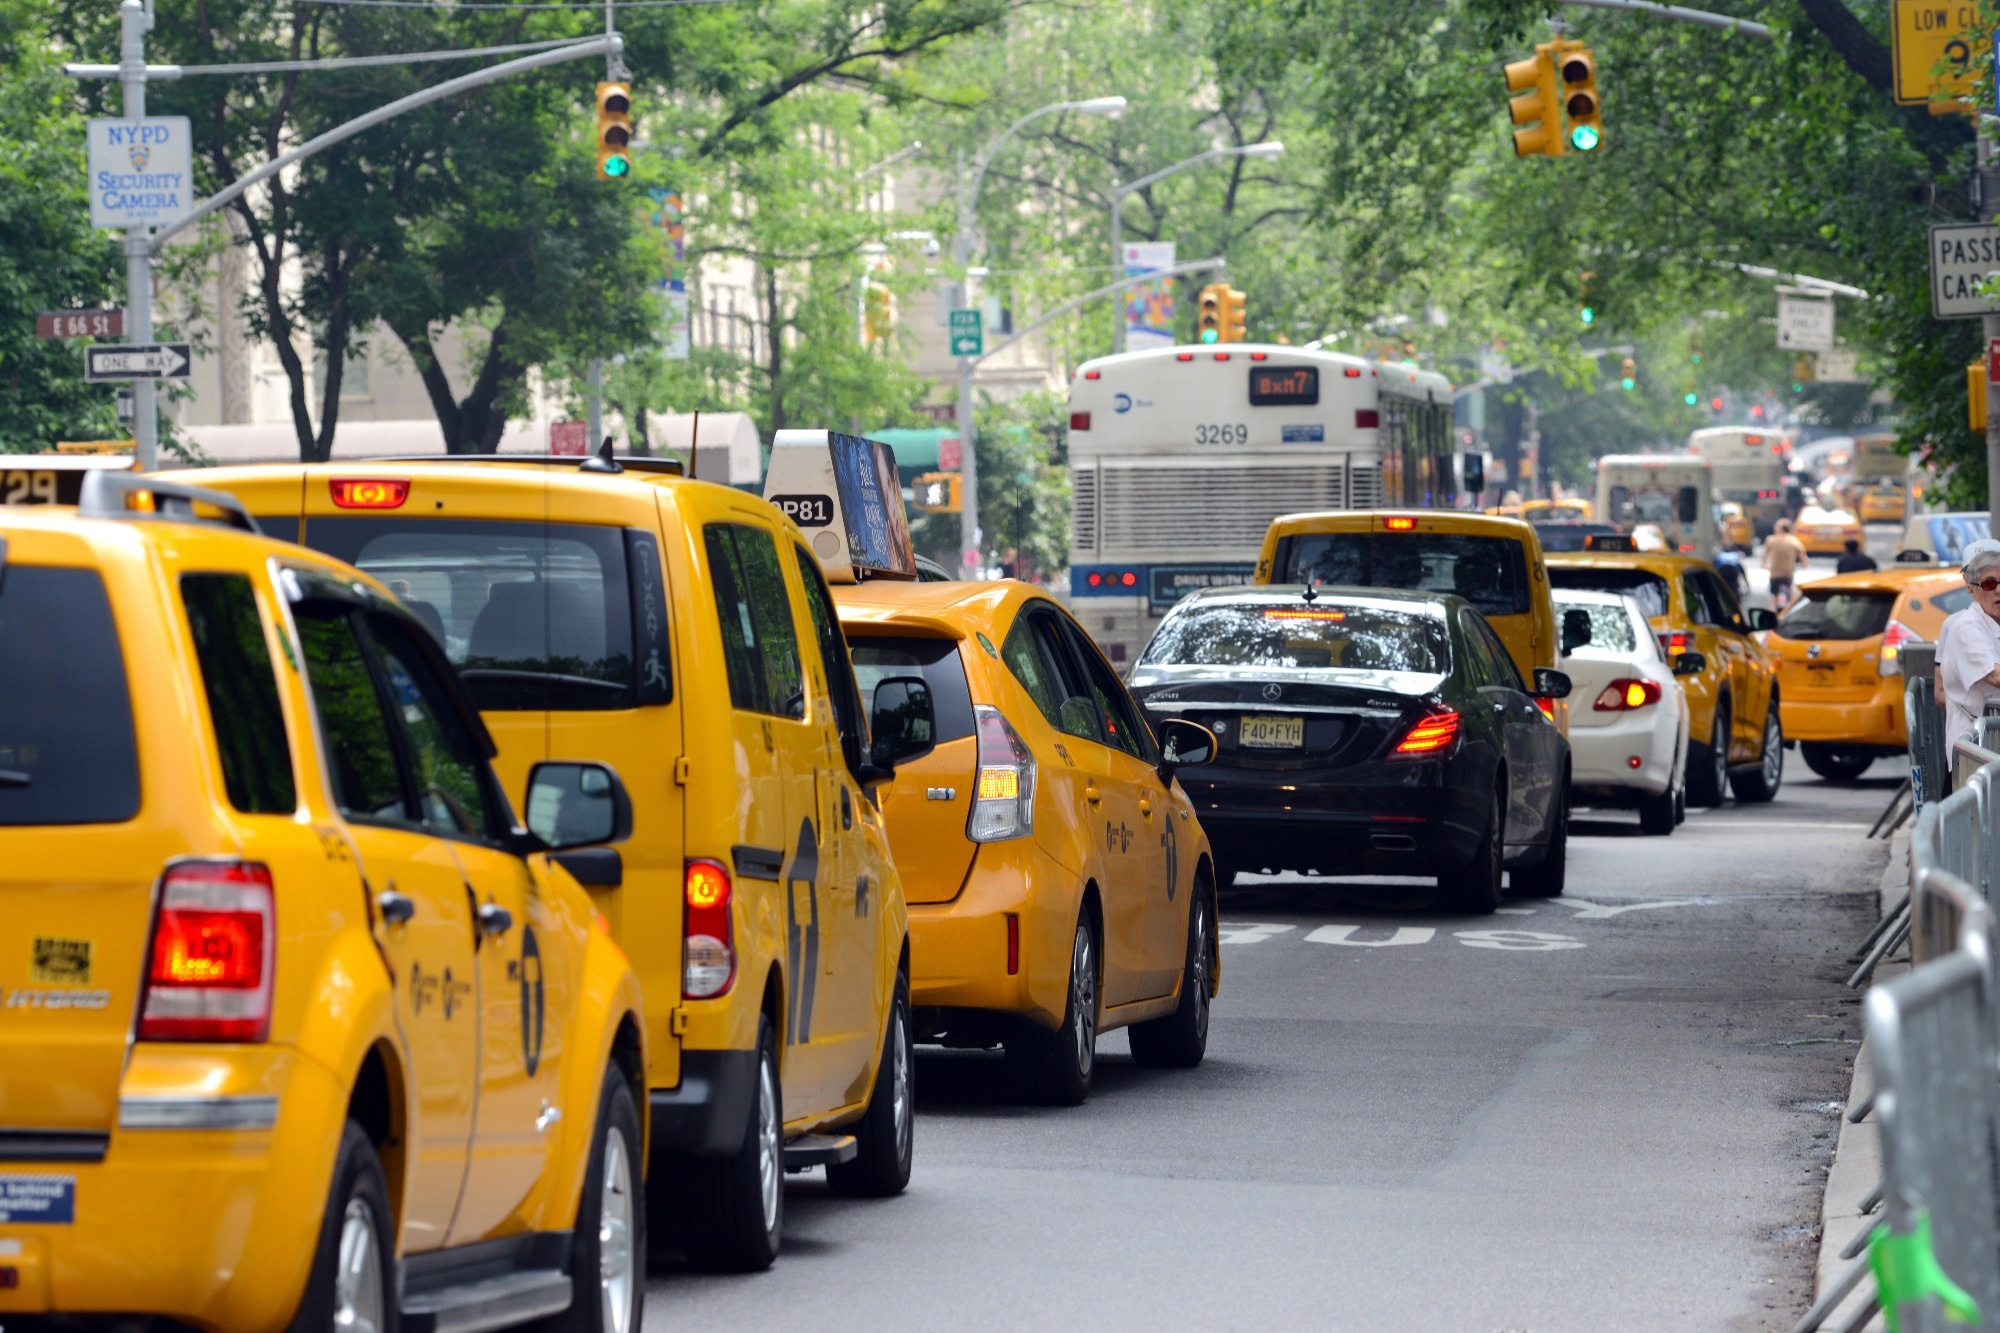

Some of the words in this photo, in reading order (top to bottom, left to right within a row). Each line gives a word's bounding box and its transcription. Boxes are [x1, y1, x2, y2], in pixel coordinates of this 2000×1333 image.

[1914, 9, 1947, 31] LOW
[1958, 7, 1985, 27] CL
[108, 125, 169, 145] NYPD
[98, 170, 182, 190] SECURITY
[102, 190, 179, 209] CAMERA
[53, 317, 62, 336] E
[68, 317, 87, 335] 66
[93, 316, 109, 333] St
[101, 355, 130, 368] ONE
[145, 354, 174, 368] WAY
[1259, 371, 1308, 395] BxM7
[1195, 424, 1248, 444] 3269
[0, 469, 57, 505] 29
